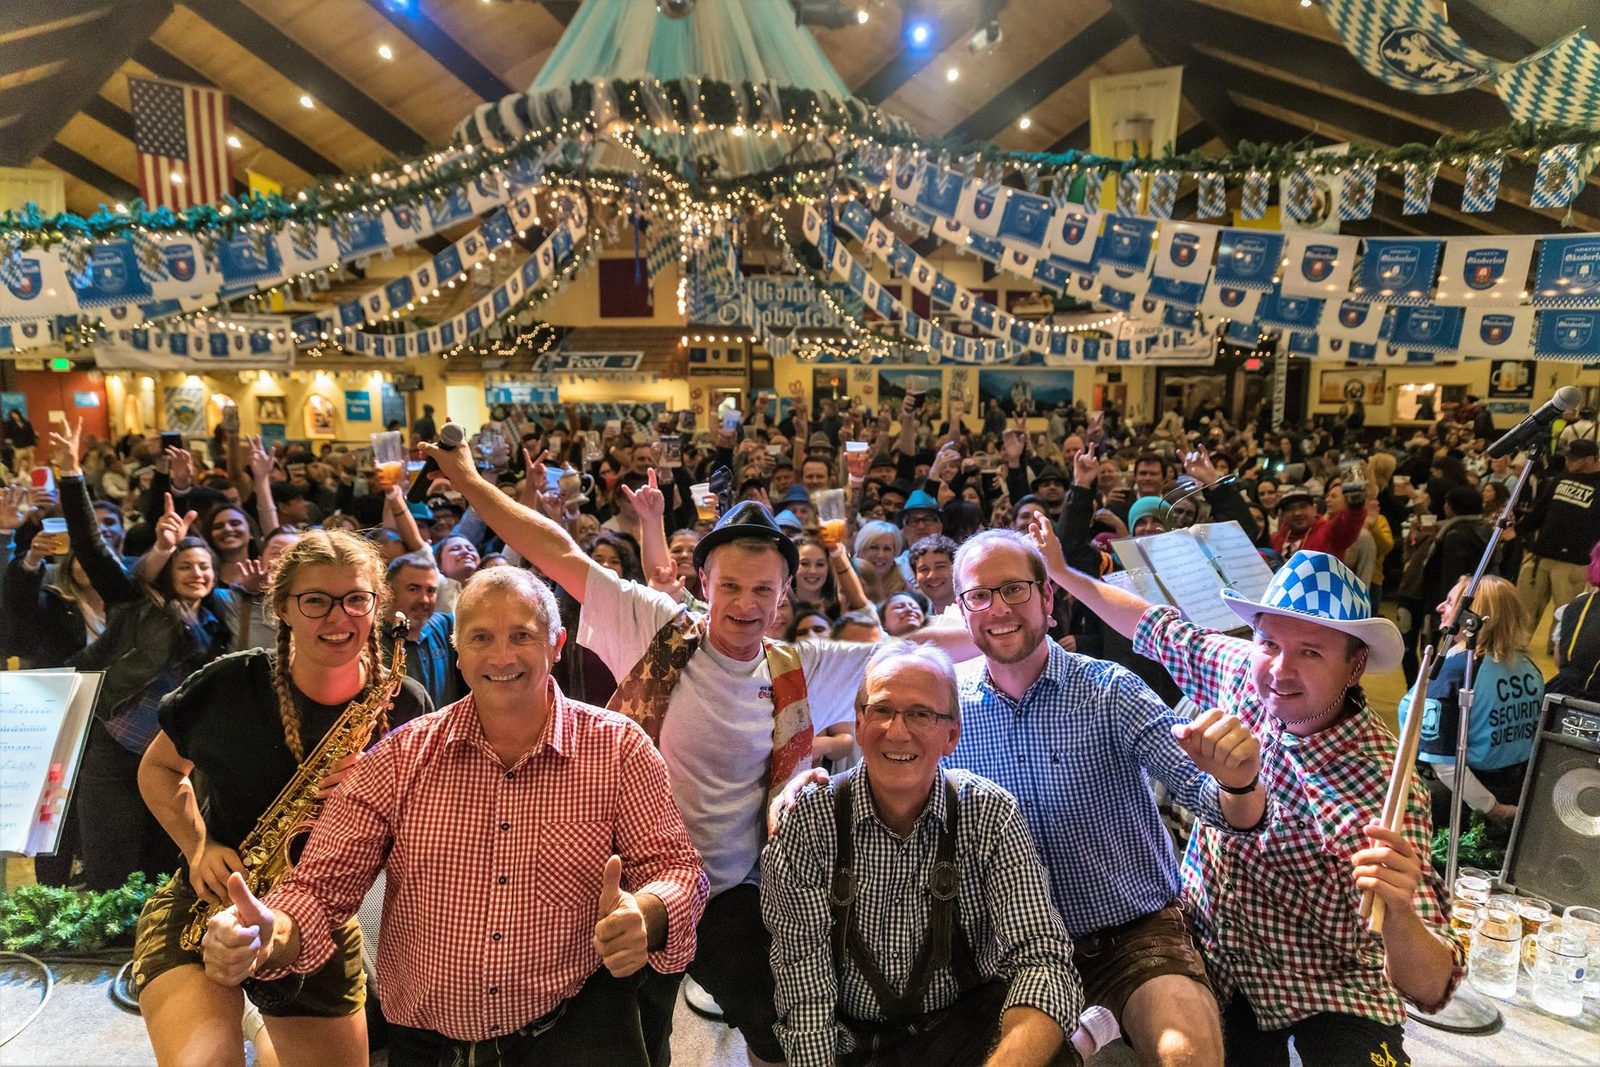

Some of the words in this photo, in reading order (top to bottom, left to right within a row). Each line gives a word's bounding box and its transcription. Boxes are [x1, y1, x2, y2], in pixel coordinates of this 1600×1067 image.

[566, 354, 608, 369] Food
[1554, 482, 1593, 502] GRIZZLY
[1496, 672, 1538, 702] CSC
